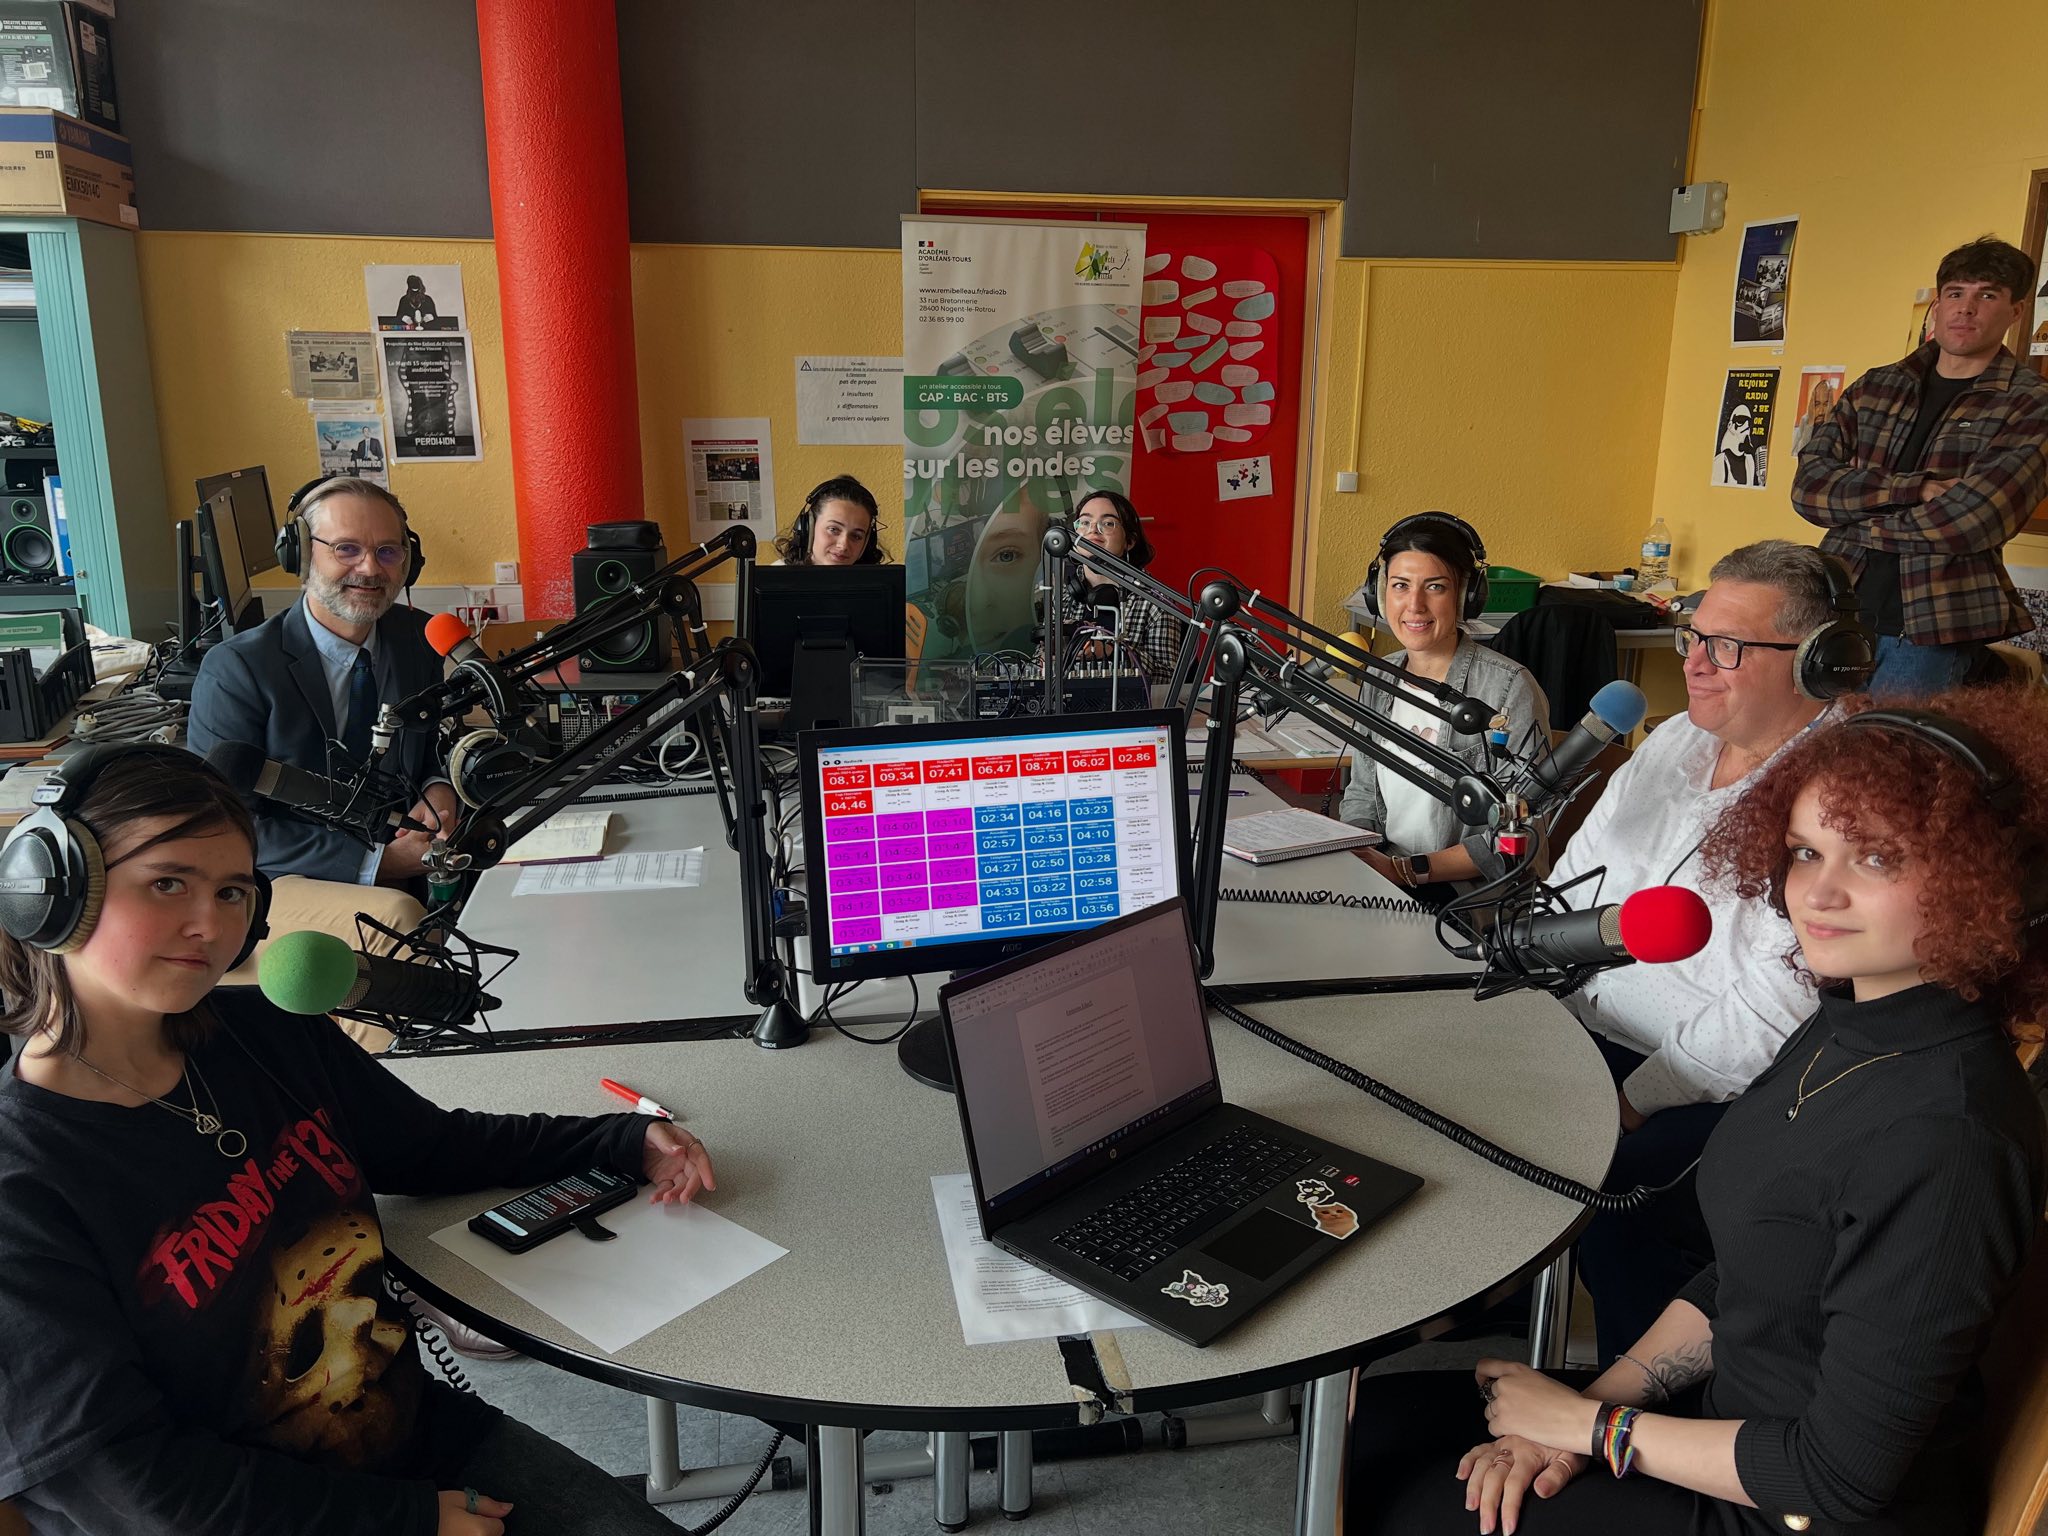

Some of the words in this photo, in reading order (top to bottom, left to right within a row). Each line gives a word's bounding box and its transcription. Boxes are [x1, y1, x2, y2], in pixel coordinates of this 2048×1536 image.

[940, 305, 996, 313] Nogent-le-Rotrou
[1739, 380, 1768, 389] REJOINS
[919, 393, 944, 402] CAP
[954, 393, 978, 402] BAC
[987, 393, 1009, 402] BTS
[1745, 392, 1768, 400] RADIO
[1753, 404, 1758, 412] 2
[1754, 417, 1764, 425] ON
[984, 425, 1038, 446] nos
[1045, 417, 1134, 446] élèves
[357, 459, 381, 468] Meurice
[904, 458, 951, 480] sur
[957, 452, 999, 478] les
[1007, 451, 1096, 478] ondes
[1029, 809, 1061, 819] 04:16
[1076, 805, 1108, 816] 03:23
[981, 813, 1014, 823] 02:34
[1030, 834, 1063, 844] 02:53
[1077, 830, 1109, 840] 04:10
[983, 839, 1016, 849] 02:57
[1032, 858, 1064, 869] 02:50
[1079, 854, 1111, 864] 03:28
[984, 864, 1017, 873] 04:27
[1080, 877, 1112, 888] 02:58
[986, 887, 1019, 898] 04:33
[1033, 883, 1066, 893] 03:22
[1035, 907, 1068, 918] 03:03
[1082, 904, 1114, 914] 03:56
[988, 912, 1021, 923] 05:12
[152, 1158, 275, 1309] FRIDAY
[265, 1150, 300, 1190] THE
